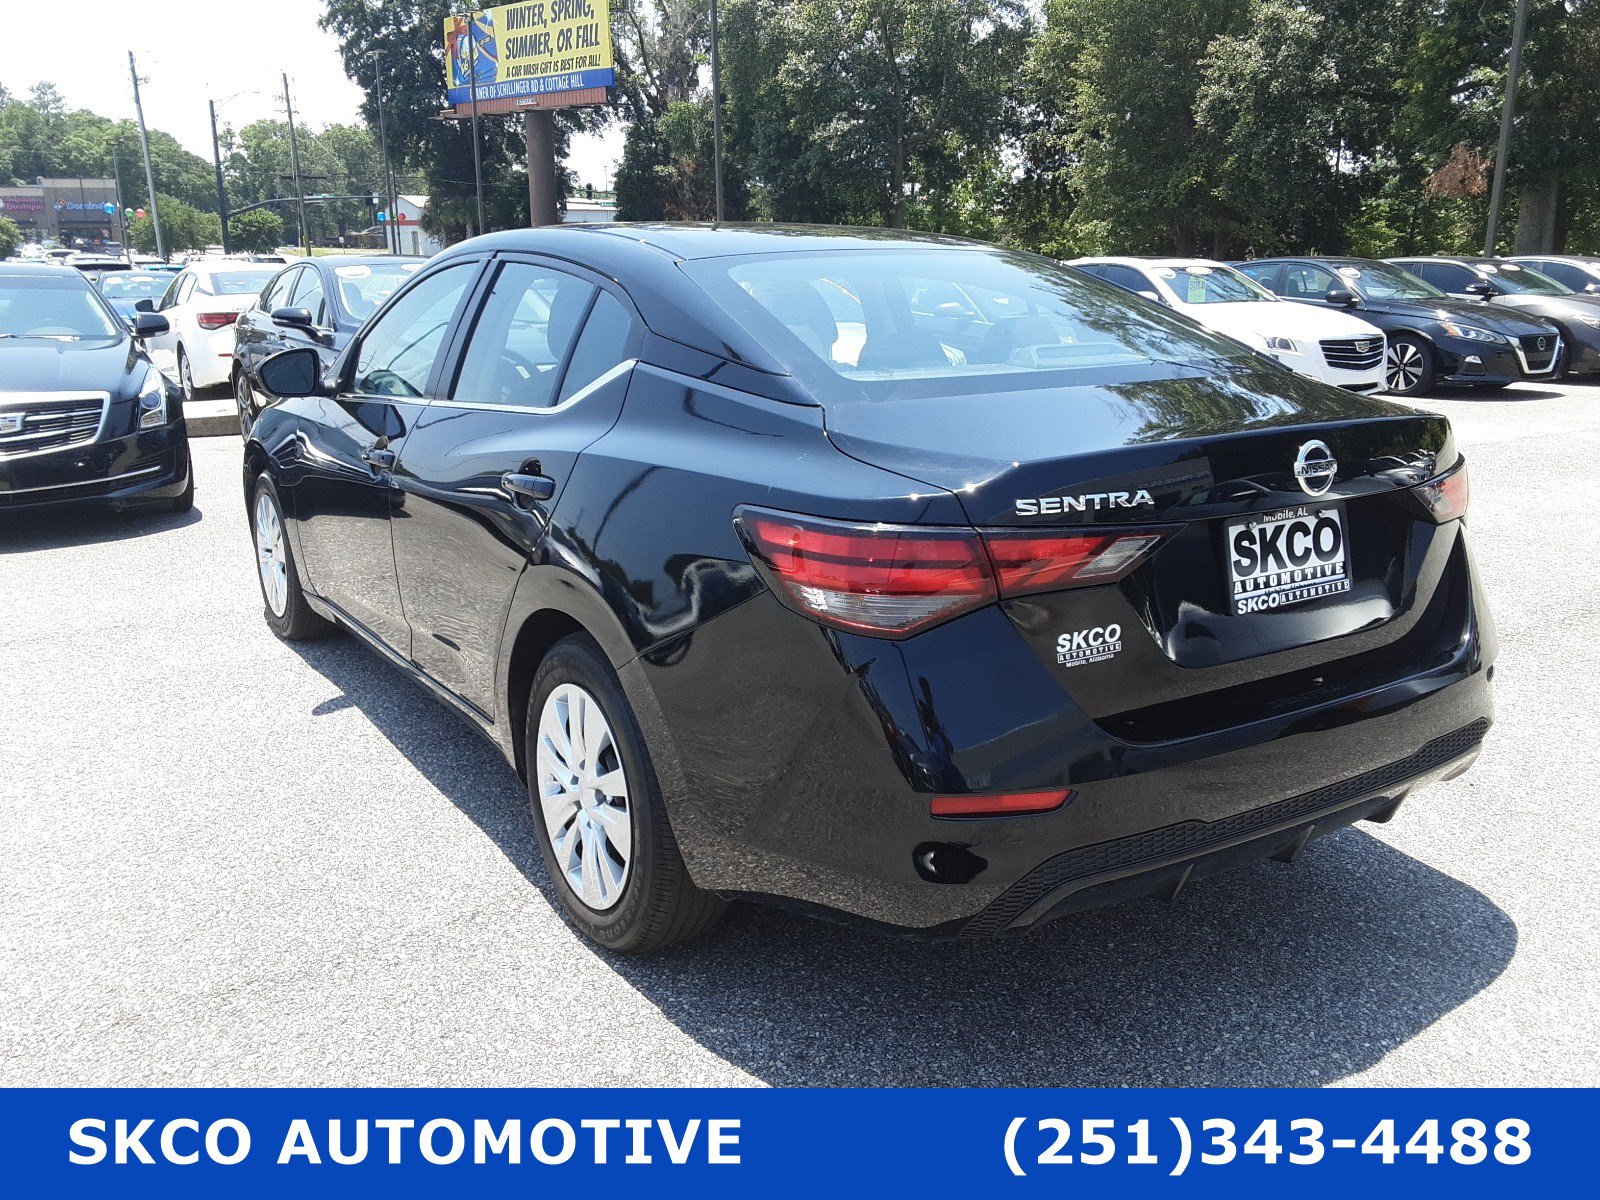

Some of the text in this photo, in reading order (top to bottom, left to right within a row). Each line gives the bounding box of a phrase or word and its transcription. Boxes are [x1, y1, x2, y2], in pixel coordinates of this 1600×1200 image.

[506, 0, 595, 31] WINTER, SPRING,
[505, 23, 600, 60] SUMMER, OR FALL
[506, 54, 601, 78] A CAR WASH GIFT IS BEST FOR ALL!
[470, 74, 584, 100] CRNER OF SCHILLINGER RD & COTTAGE HILL
[1015, 489, 1155, 516] SENTRA
[1263, 507, 1308, 522] Mobile, AL
[1233, 517, 1342, 577] SKCO
[1234, 561, 1344, 593] AUTOMOTIVE
[1237, 593, 1280, 614] SKCO
[1281, 580, 1349, 603] AUTOMOTIVE
[1056, 624, 1121, 652] SKCO
[1059, 643, 1120, 661] AUTOMOTIVE
